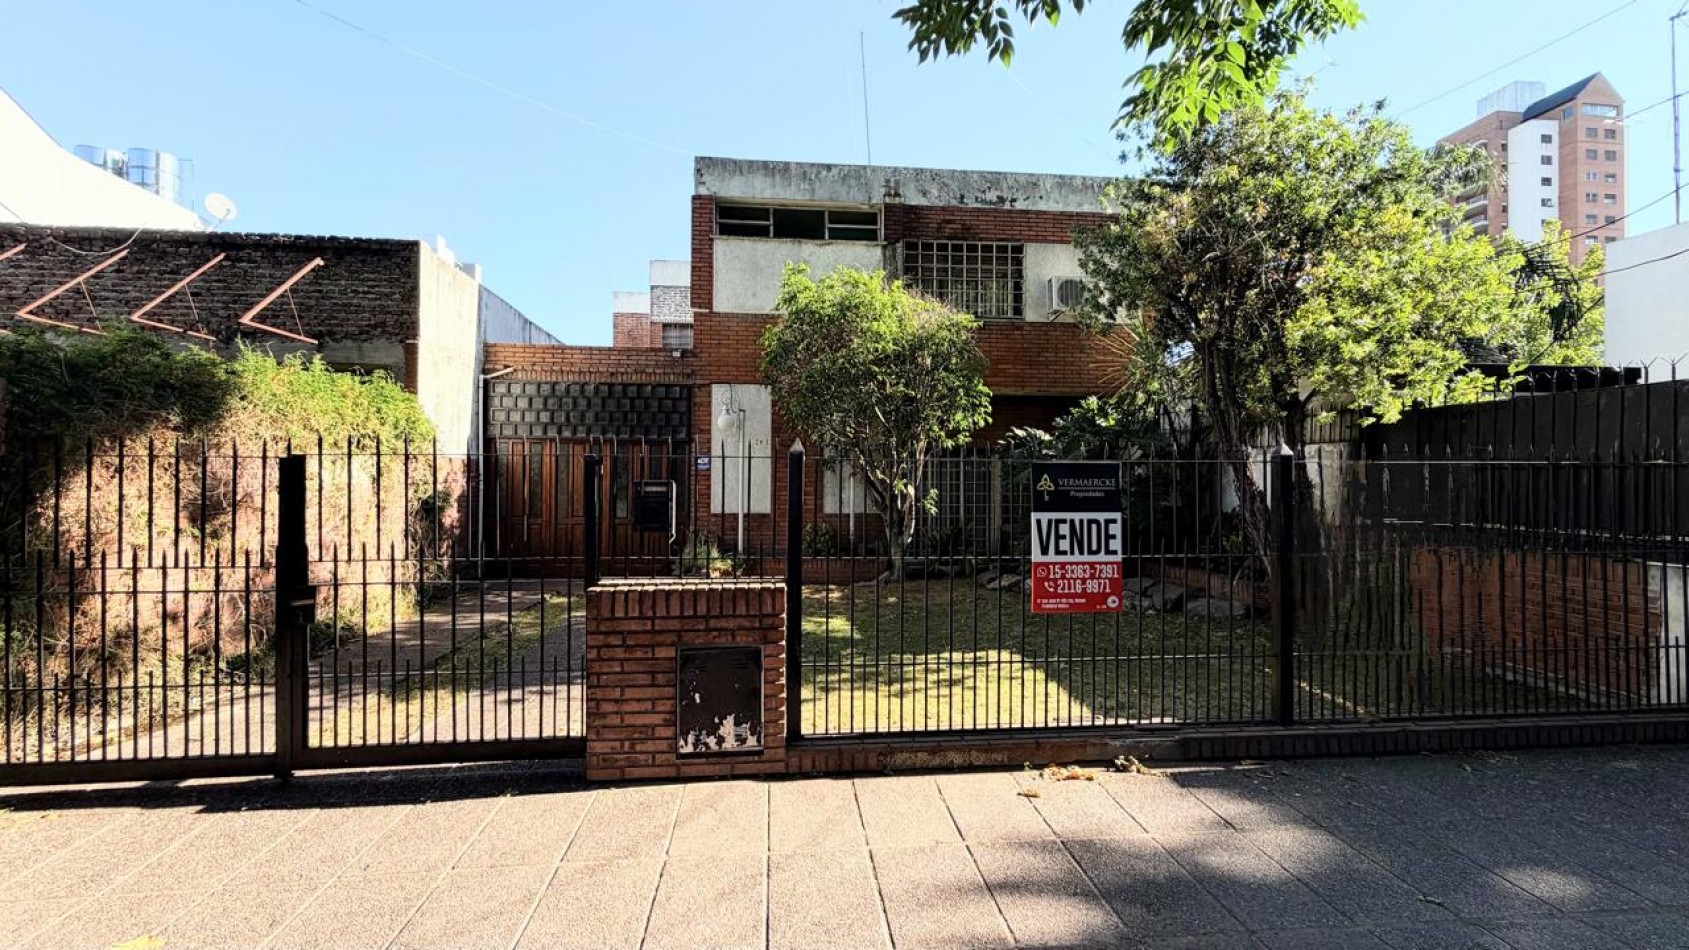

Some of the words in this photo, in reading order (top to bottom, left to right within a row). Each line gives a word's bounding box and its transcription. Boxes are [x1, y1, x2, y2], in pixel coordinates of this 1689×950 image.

[1058, 478, 1116, 487] VERMAERCKE
[1036, 518, 1119, 556] VENDE
[1048, 564, 1119, 579] 15-3363-7391
[1057, 579, 1111, 593] 2116-9971
